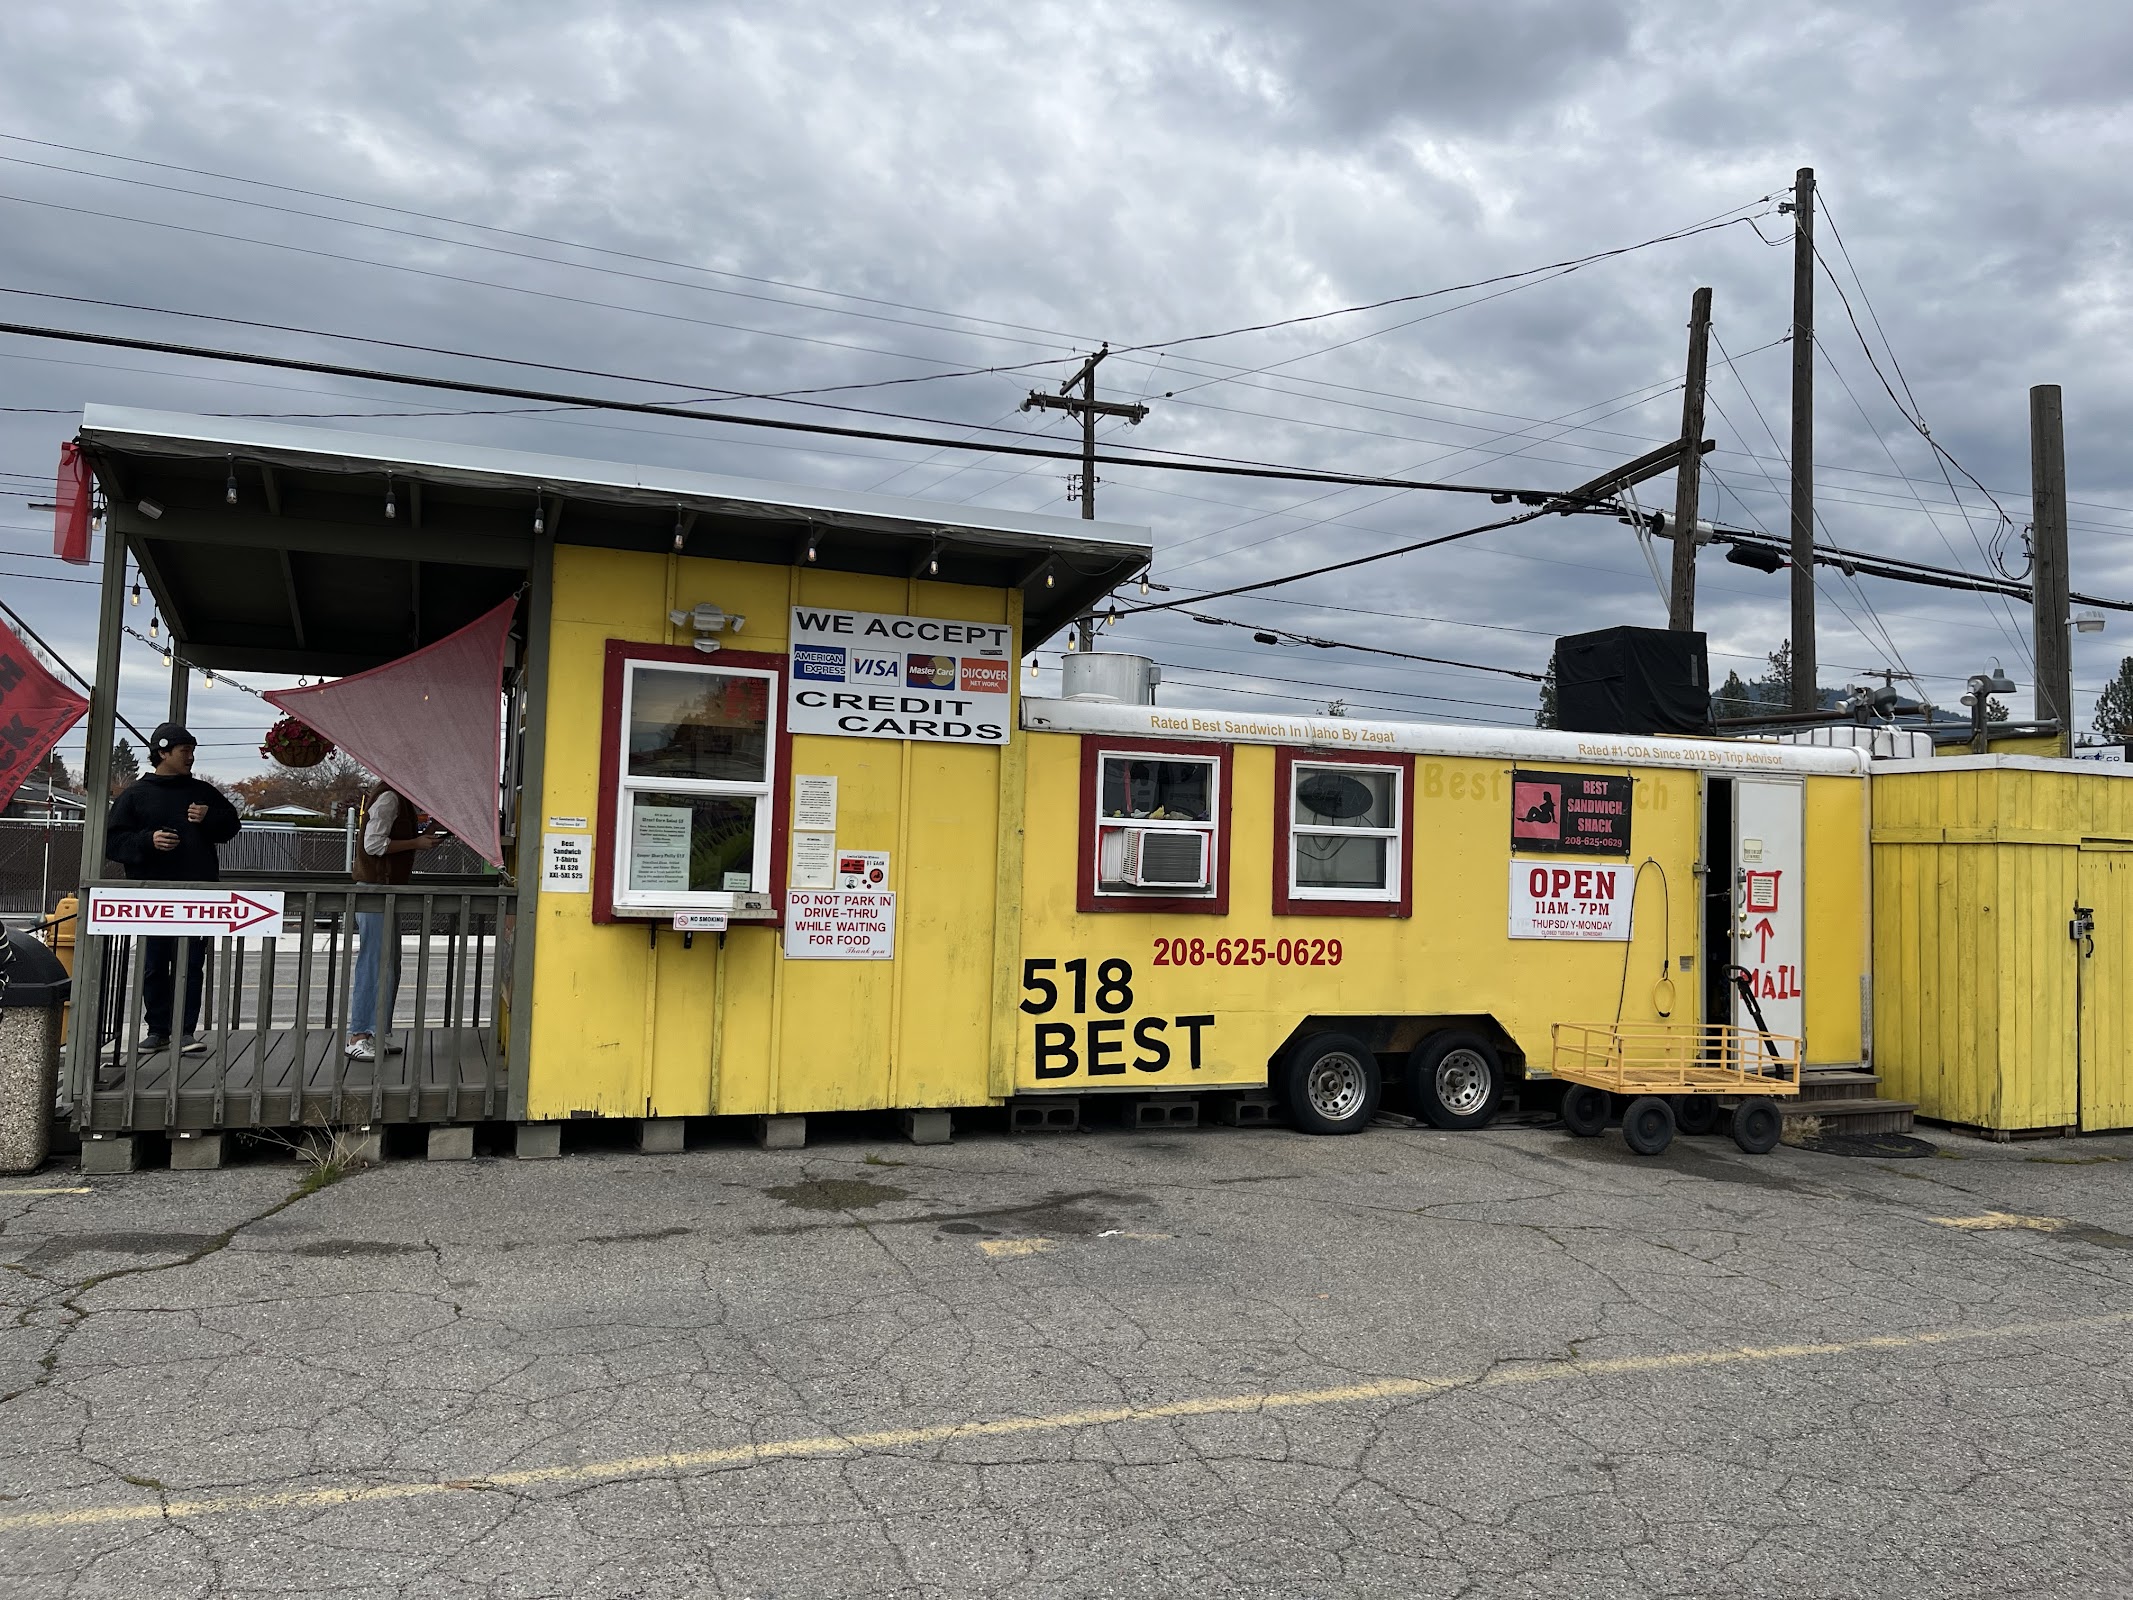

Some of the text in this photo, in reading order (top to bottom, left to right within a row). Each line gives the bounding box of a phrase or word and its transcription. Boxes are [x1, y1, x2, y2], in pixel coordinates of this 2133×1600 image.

[796, 611, 1008, 647] WE ACCEPT
[794, 651, 843, 664] AMERICAN
[804, 664, 846, 675] EXPRESS
[853, 658, 898, 677] VISA
[962, 667, 1007, 681] DISCOVER
[795, 691, 973, 716] CREDIT
[838, 716, 1003, 740] CARDS
[1150, 715, 1189, 730] Rated
[1192, 718, 1221, 733] Best
[1225, 720, 1286, 737] Sandwich
[1290, 724, 1301, 737] In
[1342, 728, 1358, 742] By
[1361, 729, 1395, 743] Zagat
[0, 712, 39, 770] CK
[1578, 743, 1783, 765] Rated #1-CDA Since 2012 By Trip Advisor
[1424, 763, 1668, 811] Best ch
[1583, 780, 1609, 796] BEST
[1567, 798, 1622, 815] SANDWICH
[1577, 818, 1612, 833] SHACK
[1565, 836, 1622, 847] 208-625-0629
[1529, 868, 1616, 900] OPEN
[791, 894, 891, 906] DO NOT PARK IN
[1535, 901, 1569, 915] 11AM
[100, 904, 250, 920] DRIVE THRU
[804, 908, 878, 919] DRIVE-THRU
[795, 921, 886, 932] WHILE WAITING
[809, 935, 871, 945] FOR FOOD
[845, 946, 870, 955] Thank
[1153, 937, 1343, 966] 208-625-0629
[1019, 958, 1133, 1015] 518
[1034, 1014, 1215, 1080] BEST
